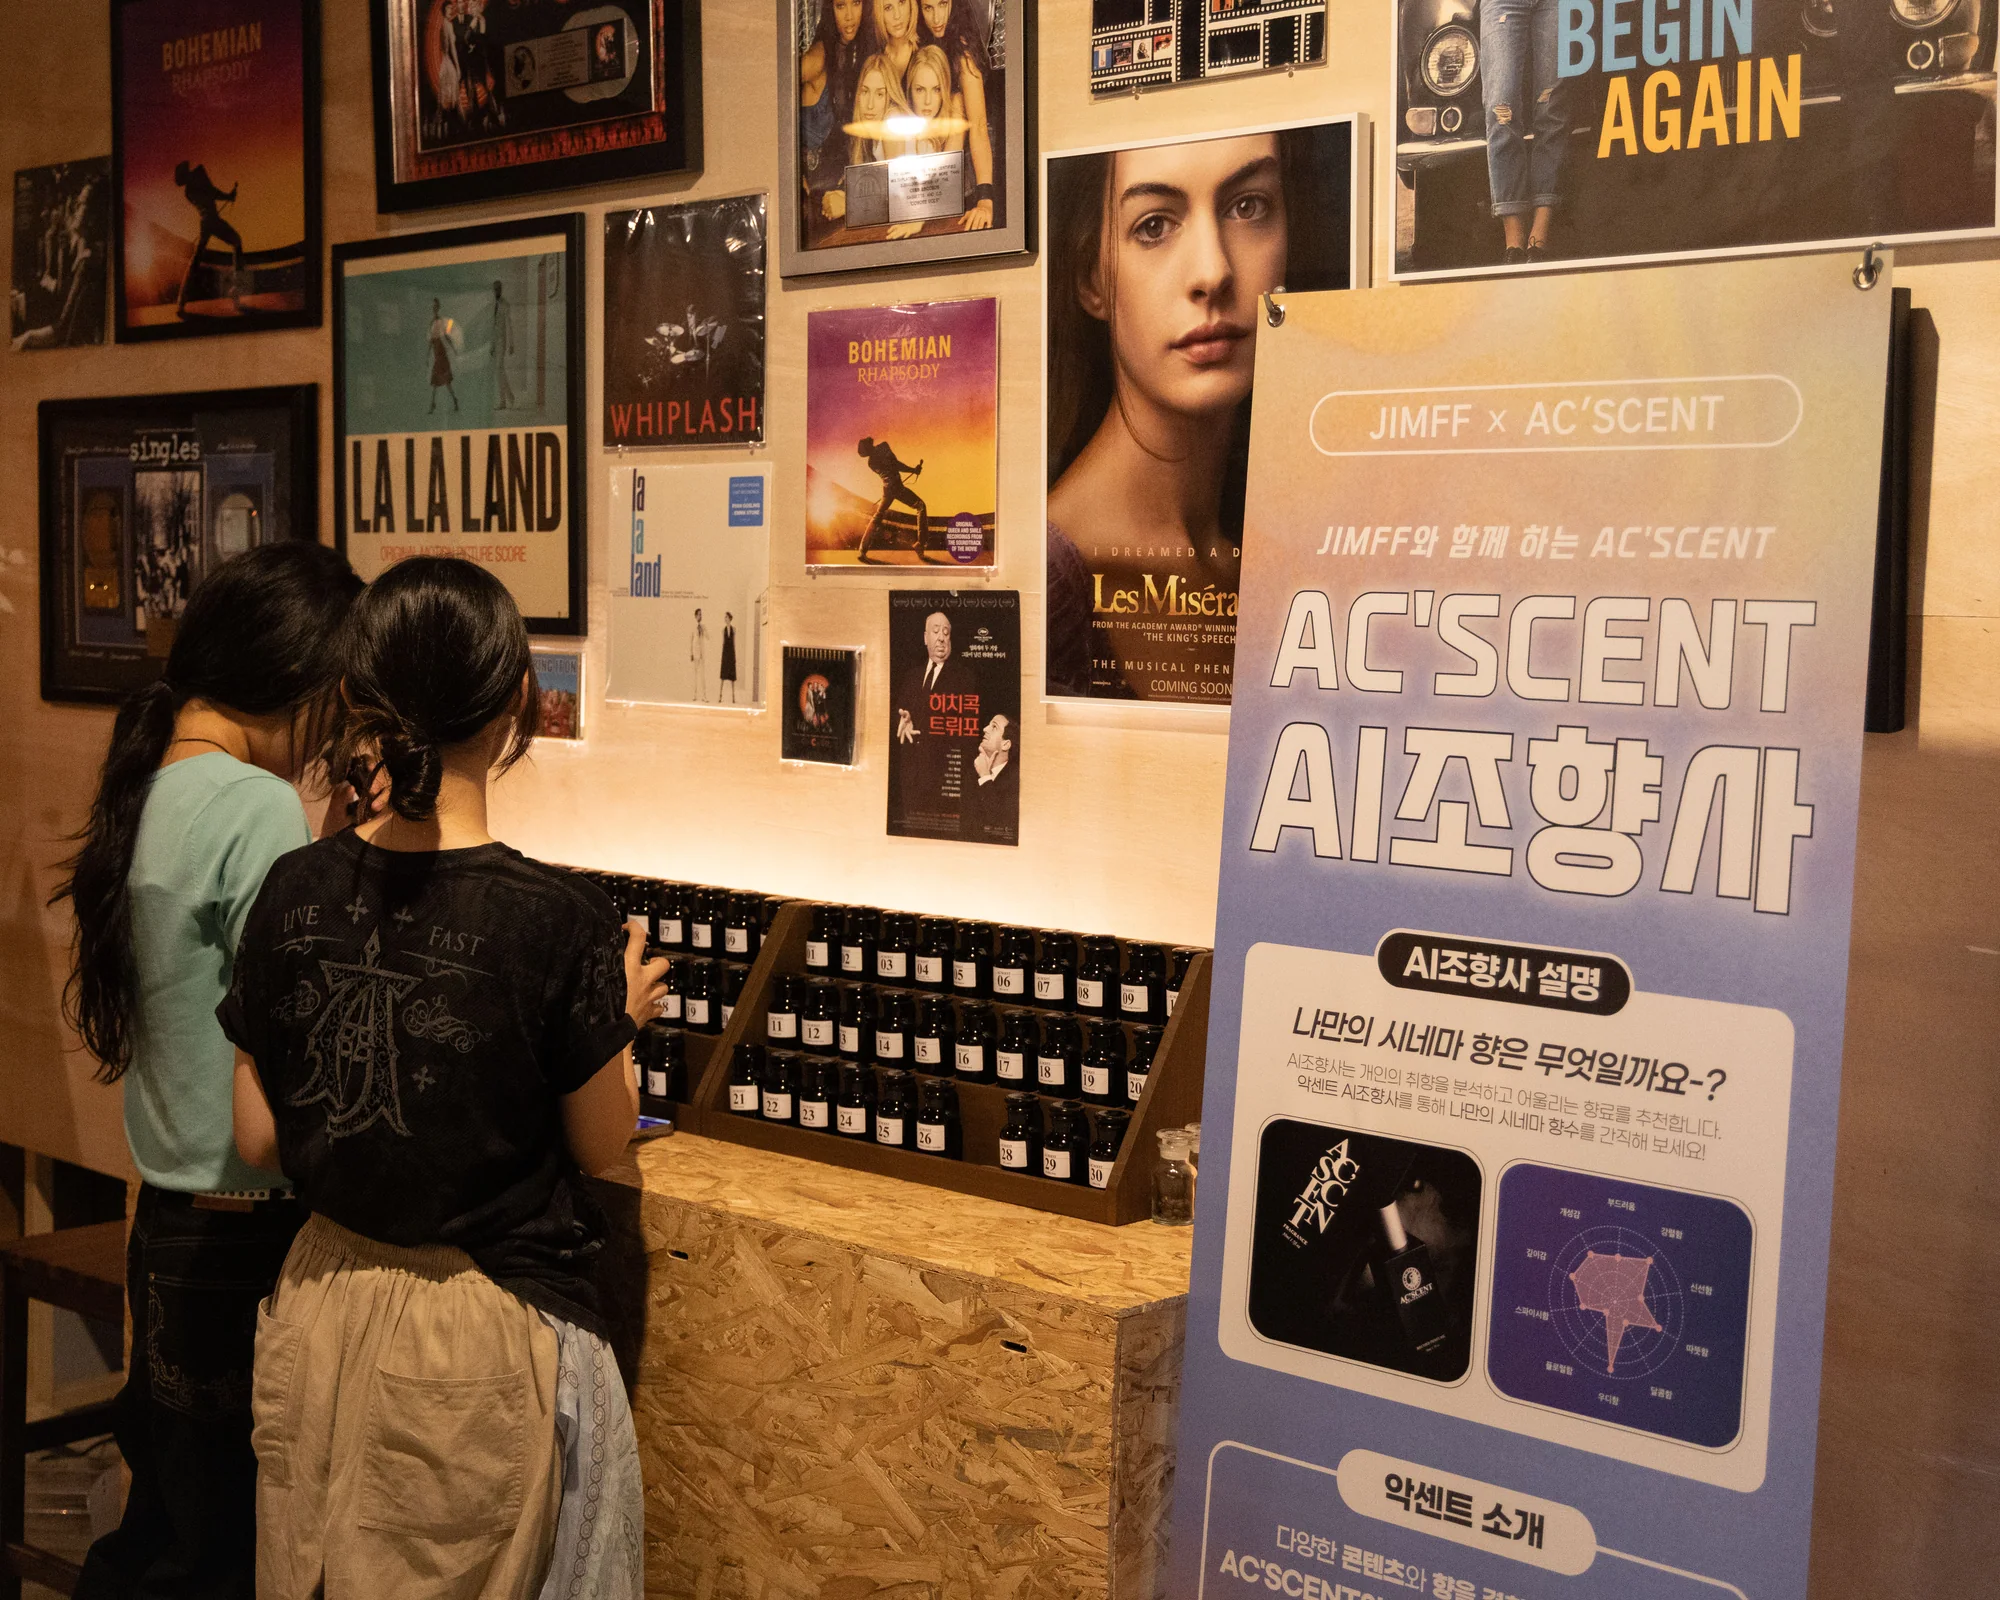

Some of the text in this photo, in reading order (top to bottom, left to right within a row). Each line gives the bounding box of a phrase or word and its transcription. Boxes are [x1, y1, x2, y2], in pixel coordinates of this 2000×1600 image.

[1557, 0, 1753, 78] BEGIN
[162, 22, 261, 71] BOHEMIAN
[1598, 54, 1801, 158] AGAIN
[848, 335, 951, 363] BOHEMIAN
[857, 364, 940, 386] RHAPSODY
[610, 397, 757, 437] WHIPLASH
[1369, 404, 1472, 440] JIMFF
[1525, 395, 1725, 436] AC'SCENT
[129, 434, 200, 465] singles
[353, 432, 562, 533] LA LA LAND
[632, 468, 645, 512] la
[631, 511, 644, 555] la
[1317, 524, 1776, 560] JIMFF와 함께 하는 AC'SCENT
[1112, 547, 1195, 557] DREAMED
[1210, 548, 1217, 557] A
[630, 554, 661, 597] land
[1092, 573, 1139, 613] Les
[1092, 620, 1113, 630] FROM
[1116, 621, 1129, 630] THE
[1131, 622, 1168, 631] ACADEMY
[1167, 633, 1198, 643] KING'S
[1202, 634, 1236, 645] SPEECH
[1270, 590, 1817, 713] AC'SCENT
[1092, 659, 1230, 675] THE MUSICAL PHEN
[1150, 679, 1233, 696] COMING SOON
[929, 693, 980, 714] 히치콕
[929, 716, 980, 737] 트뤼포
[1249, 721, 1814, 915] AI조향사
[283, 905, 486, 956] LIVE FAST
[880, 959, 893, 971] 03
[917, 963, 929, 975] 04
[997, 974, 1011, 987] 06
[1403, 946, 1601, 1002] AI조향사 설명
[1037, 980, 1050, 993] 07
[1078, 986, 1089, 999] 08
[1122, 992, 1135, 1005] 09
[771, 1020, 782, 1032] 11
[807, 1027, 820, 1040] 12
[878, 1040, 890, 1052] 14
[915, 1044, 927, 1058] 15
[957, 1052, 970, 1065] 16
[1292, 1006, 1727, 1101] 나만의 시네마 향은 무엇일까요-?
[998, 1060, 1010, 1073] 17
[1039, 1065, 1051, 1078] 18
[1083, 1073, 1095, 1087] 19
[1129, 1081, 1142, 1095] 20
[733, 1092, 744, 1105] 21
[1286, 1052, 1722, 1140] AI조향사는 개인의 취향을 분석하고 어울리는 향료를 추천합니다.
[766, 1100, 779, 1113] 22
[802, 1108, 815, 1121] 23
[839, 1114, 852, 1127] 24
[1297, 1075, 1706, 1162] 악센트 AI조향사를 통해 나만의 시네마 향수를 간직해 보세요!
[878, 1124, 890, 1138] 25
[919, 1131, 932, 1144] 26
[1001, 1147, 1013, 1161] 28
[1044, 1157, 1057, 1171] 29
[1090, 1168, 1103, 1182] 30
[1607, 1198, 1636, 1212] 부드러움
[1560, 1207, 1581, 1219] 개성감
[1690, 1283, 1713, 1296] 신선함
[1385, 1473, 1544, 1549] 악센트 소개
[1276, 1524, 1337, 1565] 다양한
[1342, 1544, 1427, 1593] 콘텐츠와
